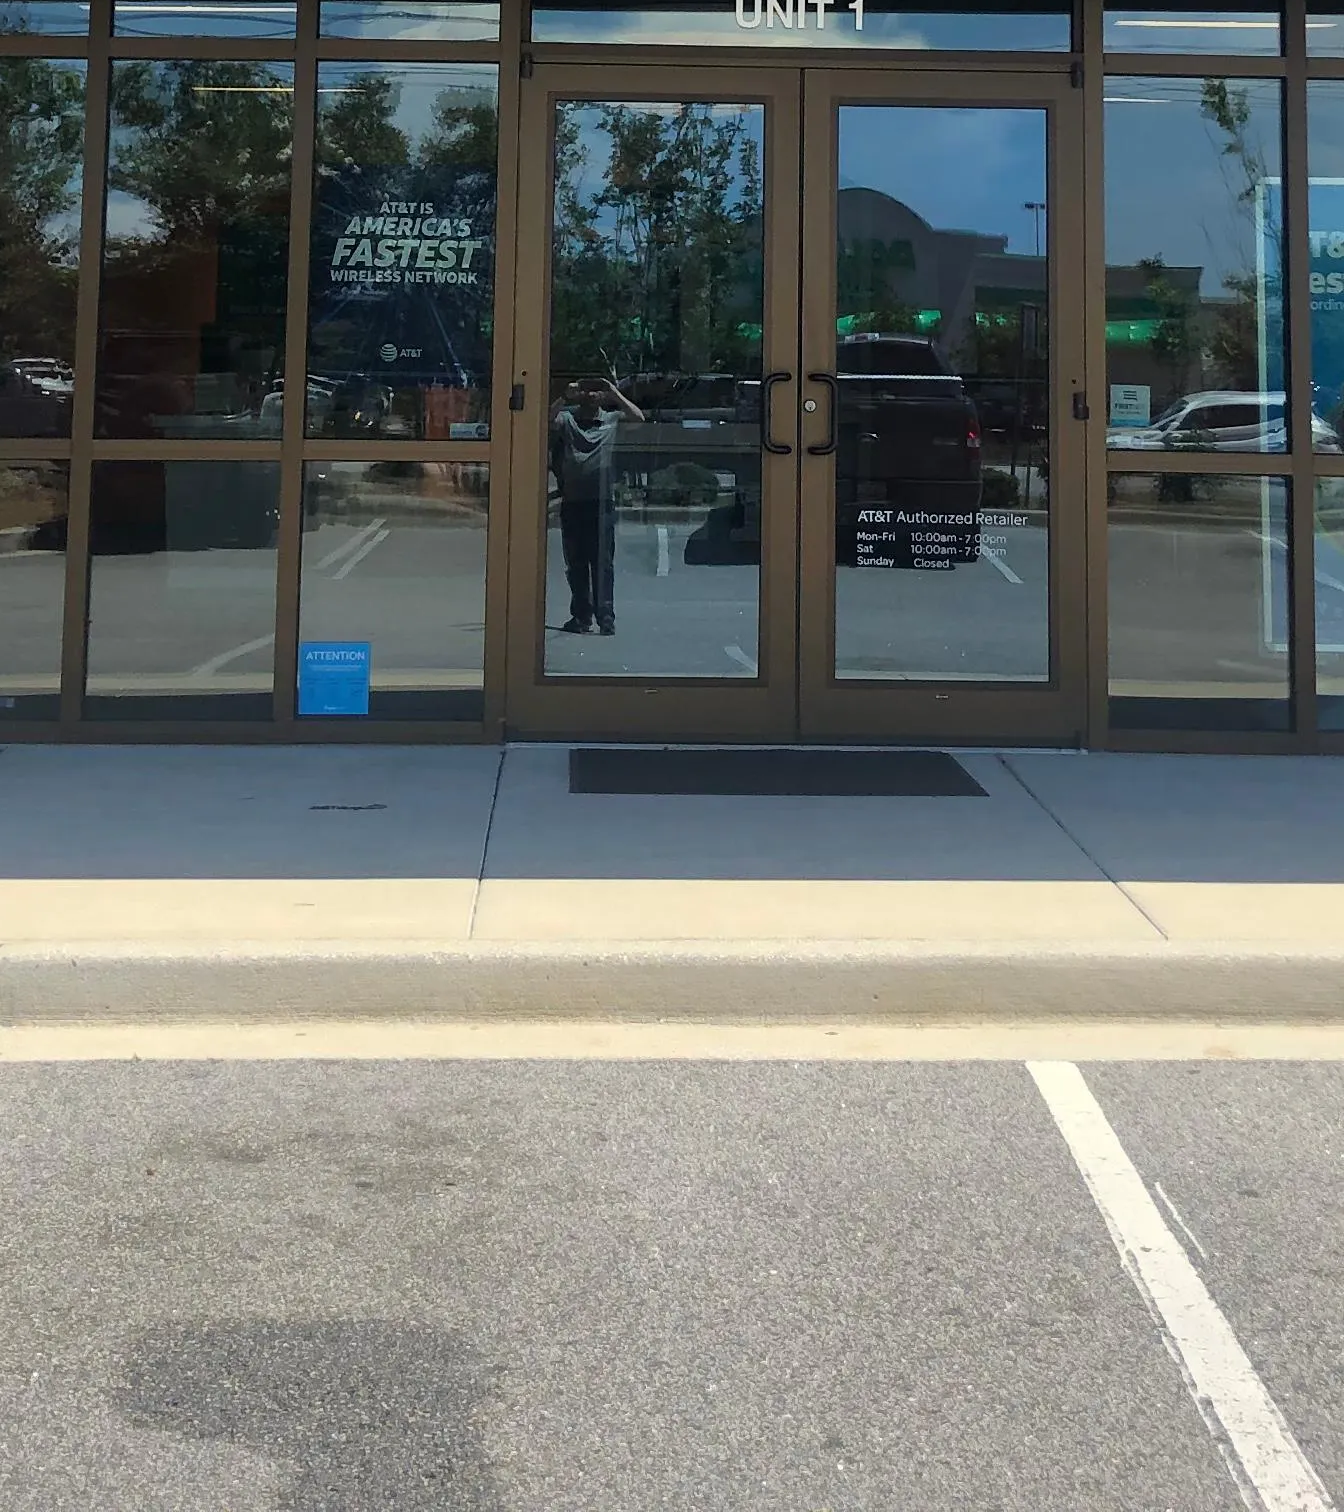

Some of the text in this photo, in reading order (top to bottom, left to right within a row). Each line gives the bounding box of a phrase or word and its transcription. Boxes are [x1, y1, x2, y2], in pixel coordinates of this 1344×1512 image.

[379, 202, 434, 214] AT&T IS
[344, 216, 472, 237] AMERICA'S
[331, 238, 482, 269] FASTEST
[330, 269, 478, 285] WIRELESS NETWORK
[399, 348, 423, 358] AT&T
[857, 510, 1028, 526] AT&T Authorized Retailer
[856, 531, 896, 542] Mon-Fri
[910, 532, 957, 543] 10:00am
[856, 543, 874, 554] Sat
[910, 544, 957, 555] 10:00am
[856, 555, 950, 568] Sunday Closed
[305, 651, 365, 661] ATTENTION
